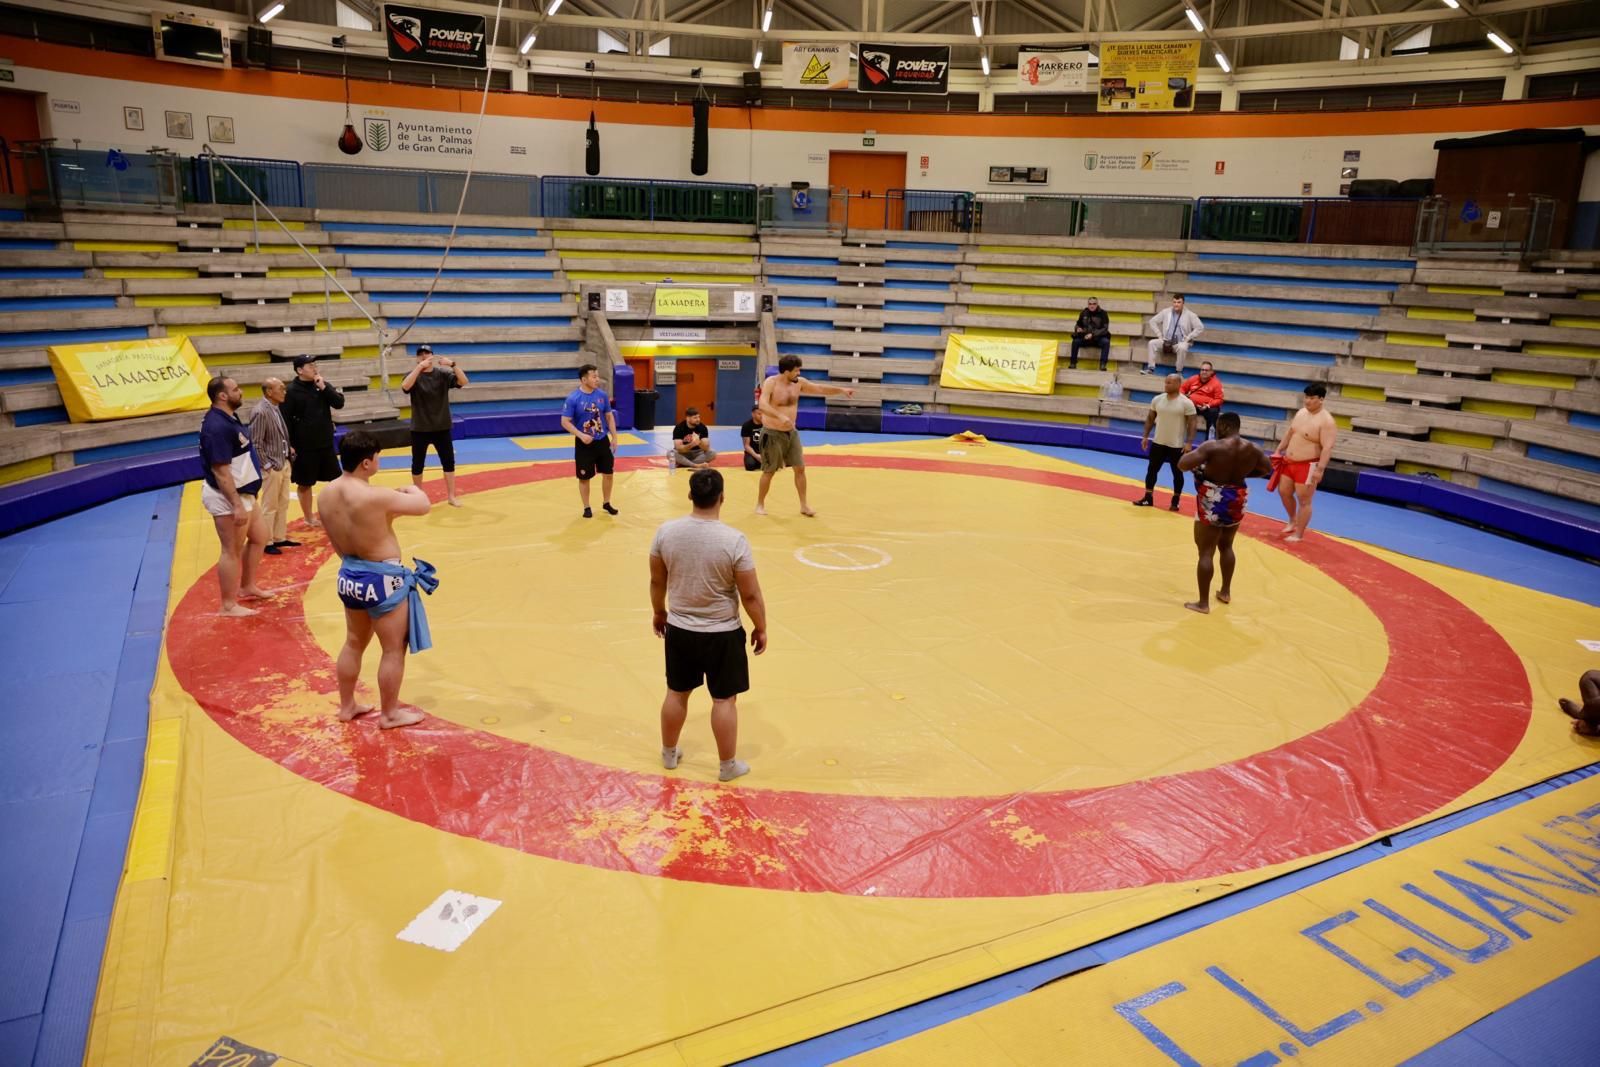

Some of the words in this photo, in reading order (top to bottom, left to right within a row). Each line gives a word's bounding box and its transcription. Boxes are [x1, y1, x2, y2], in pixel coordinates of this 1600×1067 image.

[1037, 62, 1083, 70] MARRERO
[397, 122, 472, 135] Ayuntamiento
[397, 132, 410, 141] de
[417, 133, 433, 142] Las
[440, 135, 472, 145] Palmas
[398, 142, 411, 151] de
[412, 143, 436, 153] Gran
[438, 145, 473, 155] Canaria
[658, 299, 668, 307] LA
[670, 299, 706, 307] MADERA
[960, 355, 976, 366] LA
[979, 355, 1036, 371] MADERA
[92, 373, 119, 388] LA
[118, 364, 191, 385] MADERA
[338, 576, 379, 602] OREA
